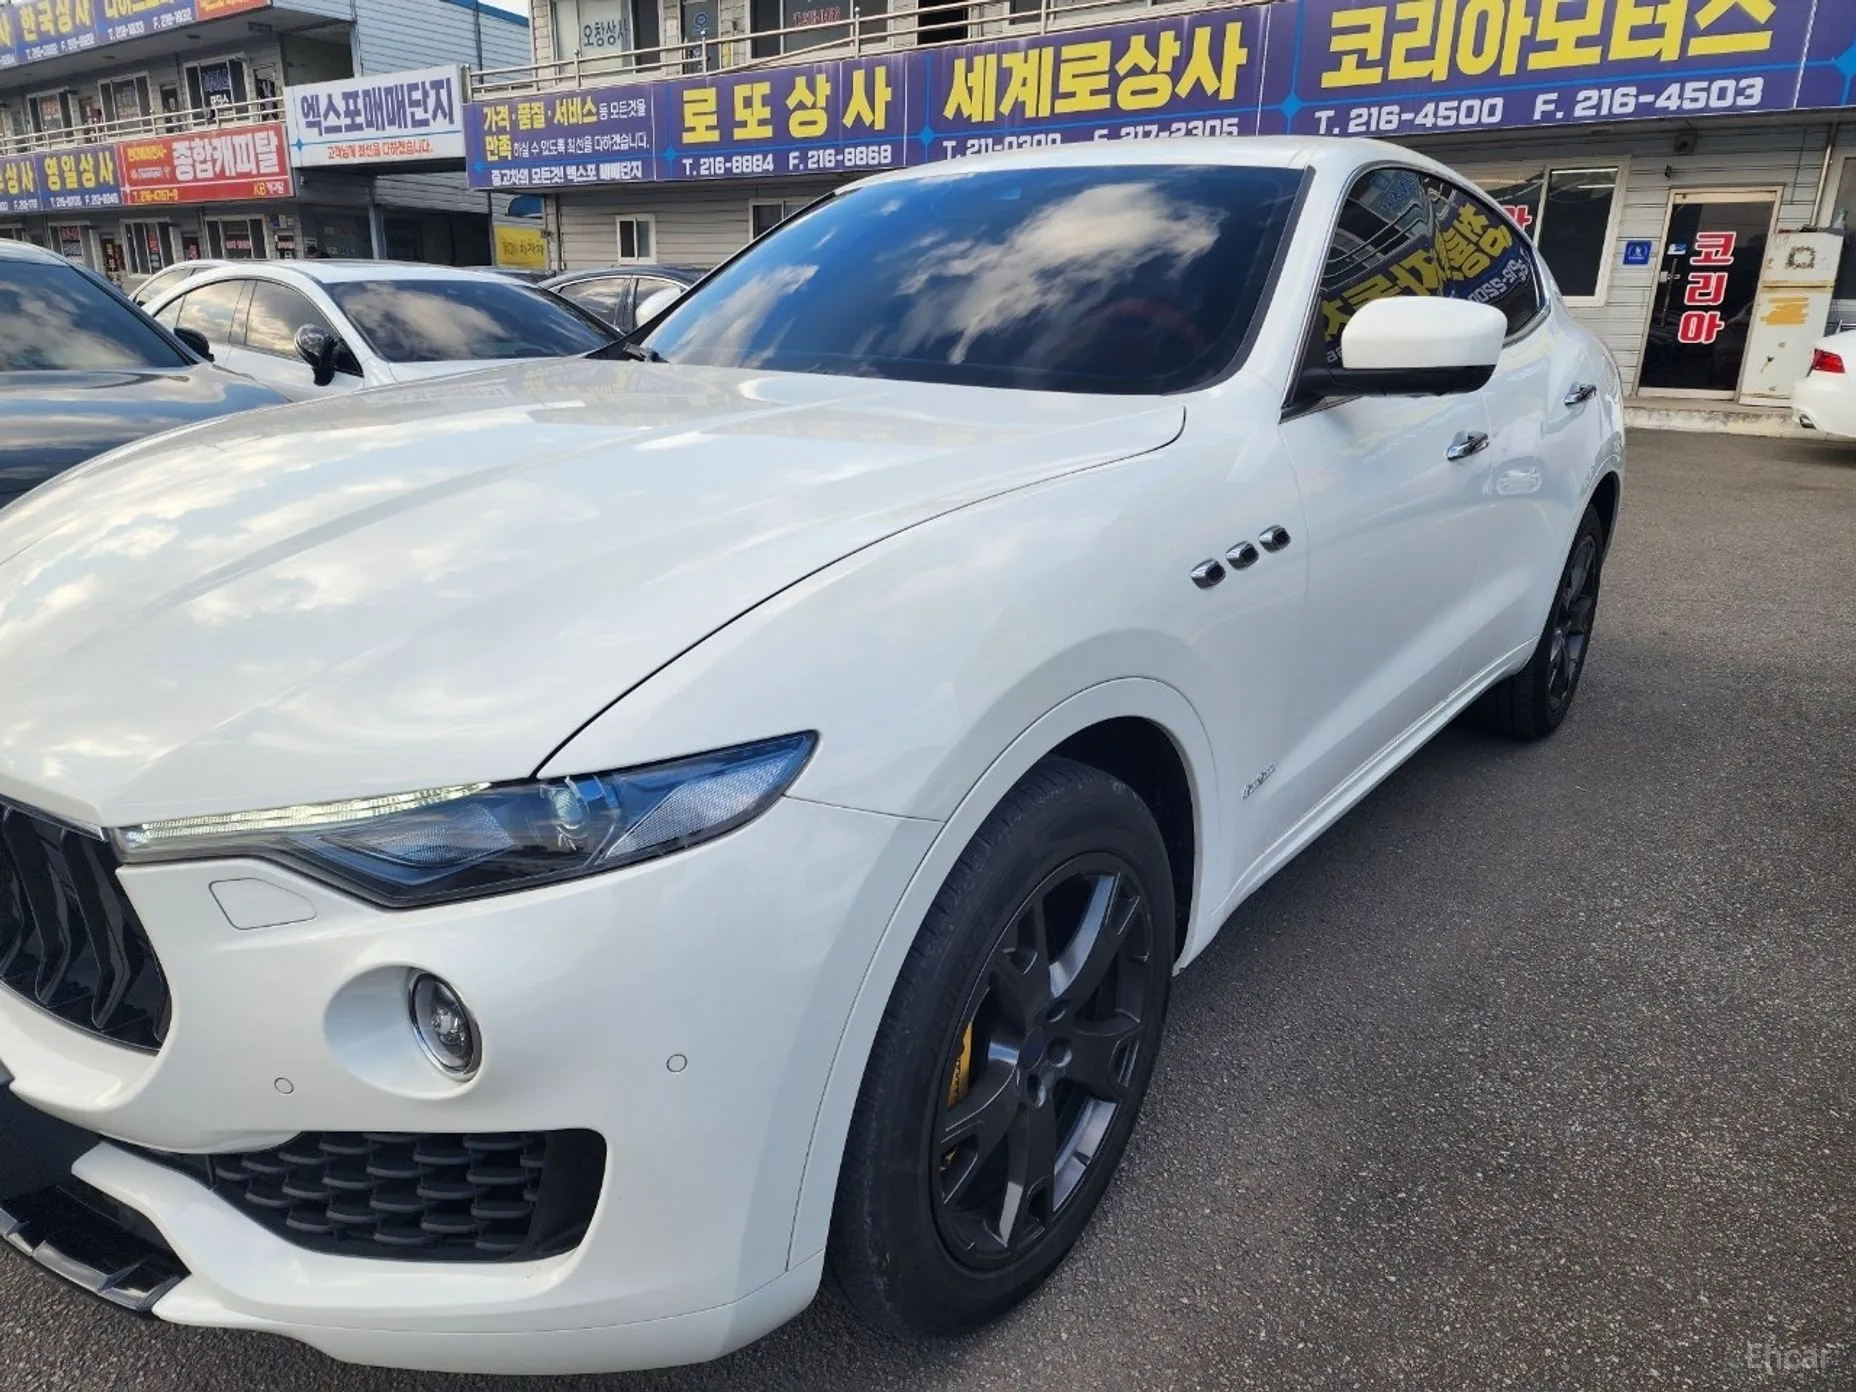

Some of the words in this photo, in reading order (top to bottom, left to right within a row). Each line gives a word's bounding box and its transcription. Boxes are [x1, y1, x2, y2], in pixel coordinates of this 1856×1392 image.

[943, 21, 1249, 122] 세계로상사
[1319, 0, 1778, 89] 코리아모터스
[300, 77, 455, 137] 엑스포매매단지
[681, 65, 893, 145] 로또상사
[1347, 97, 1504, 133] 216-4500
[1576, 76, 1765, 118] 216-4503
[44, 151, 114, 192] 영일상사
[172, 130, 280, 181] 종합캐피탈
[1679, 231, 1738, 344] 코리아
